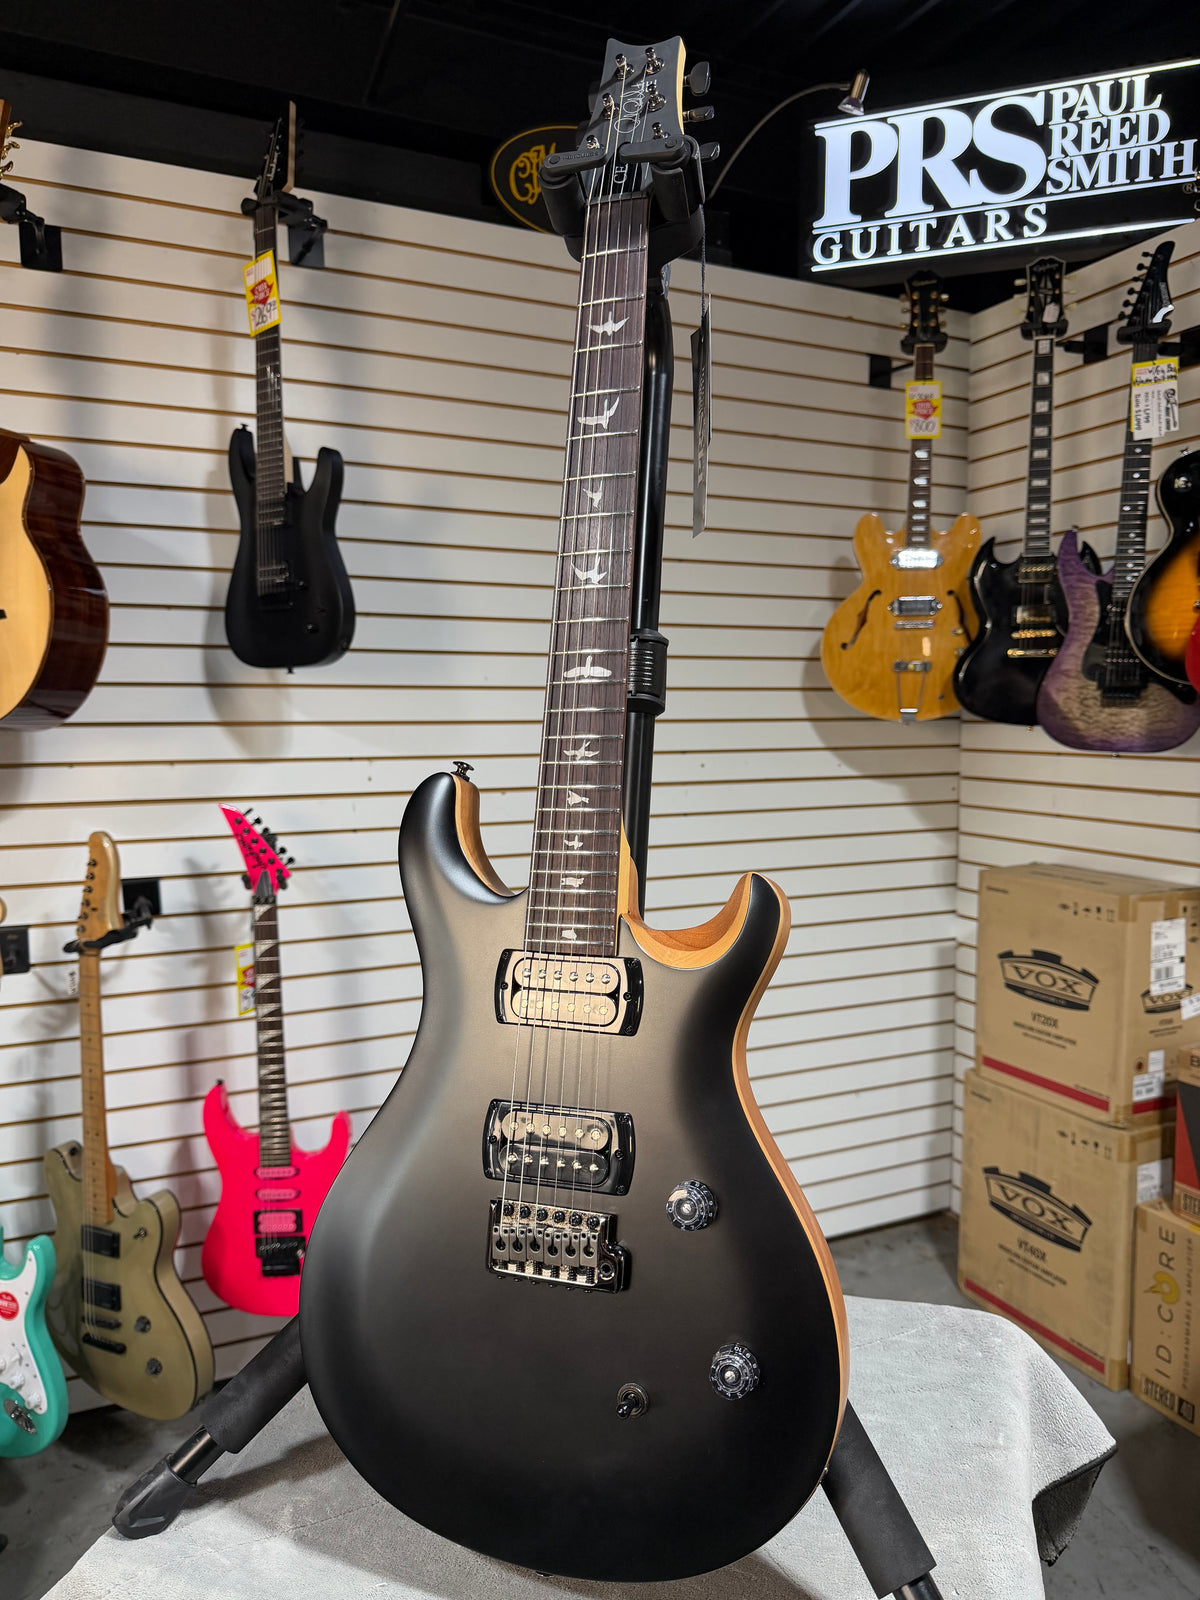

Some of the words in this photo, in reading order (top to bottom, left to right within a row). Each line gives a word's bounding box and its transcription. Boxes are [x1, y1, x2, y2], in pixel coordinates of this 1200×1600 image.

[1049, 74, 1162, 125] PAUL
[813, 91, 1047, 228] PRS
[1049, 108, 1171, 160] REED
[1045, 139, 1198, 195] SMITH
[812, 202, 1049, 264] GUITARS
[1011, 965, 1082, 996] VOX
[996, 1182, 1073, 1234] VOX
